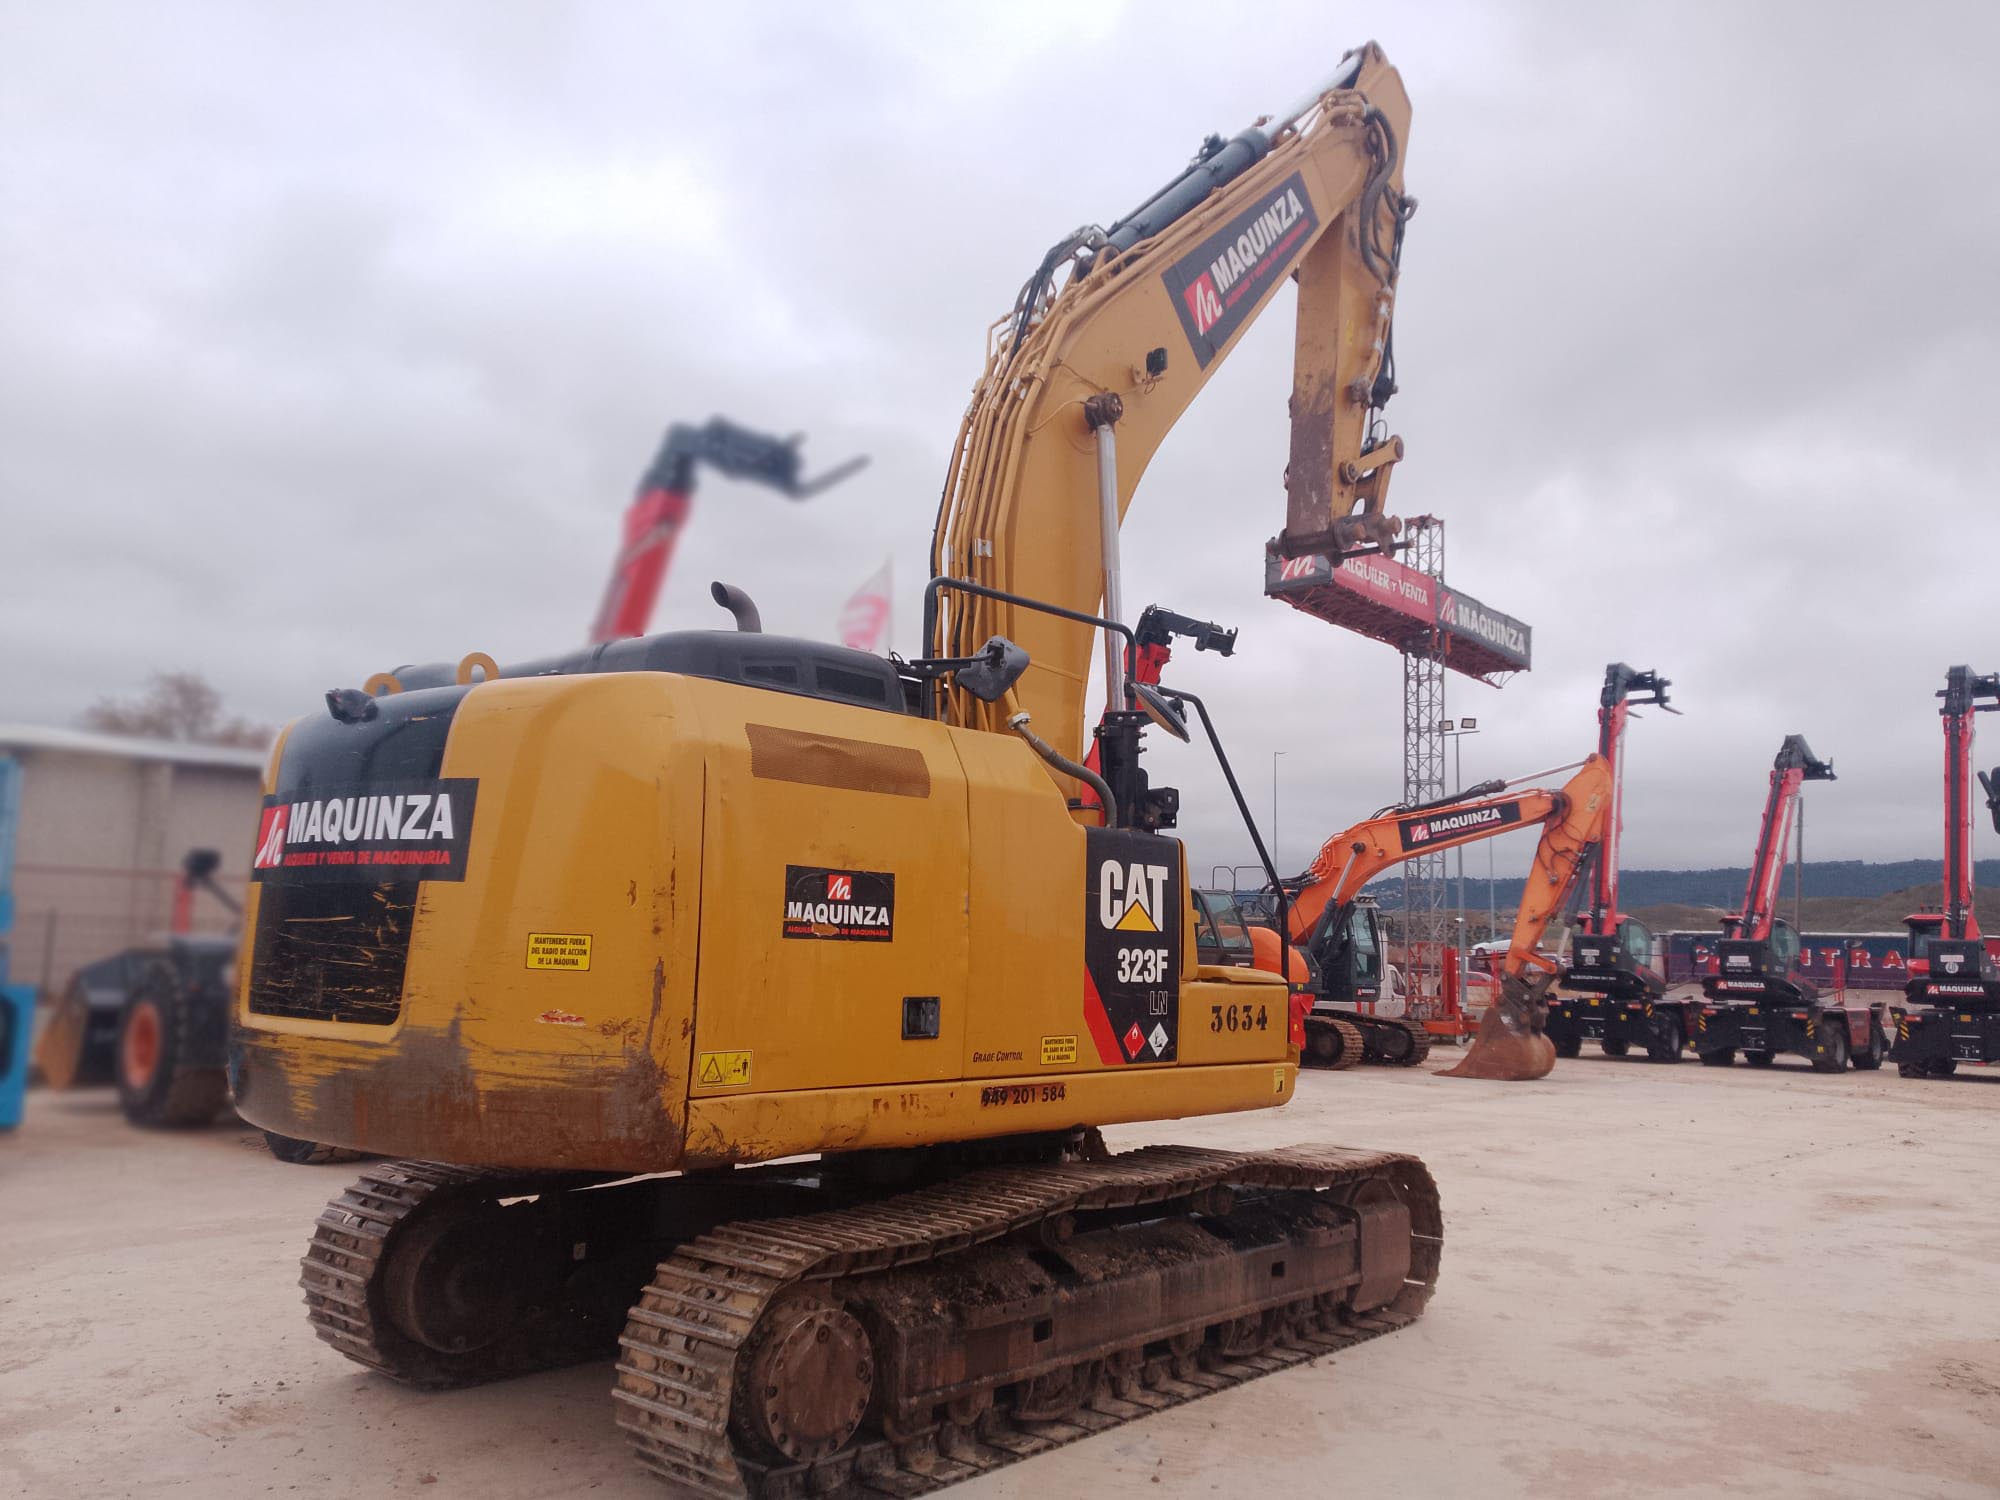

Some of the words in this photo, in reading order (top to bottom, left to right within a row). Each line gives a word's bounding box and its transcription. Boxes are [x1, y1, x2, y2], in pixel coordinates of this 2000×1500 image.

[1210, 188, 1304, 294] MAQUINZA
[1342, 557, 1390, 591] ALQUILER
[1398, 579, 1428, 606] VENTA
[1458, 603, 1526, 655] MAQUINZA
[286, 793, 455, 845] MAQUINZA
[1430, 808, 1501, 833] MAQUINZA
[357, 851, 371, 864] DE
[1100, 859, 1169, 932] CAT
[787, 901, 890, 926] MAQUINZA
[531, 947, 541, 955] DEL
[542, 947, 559, 955] RADIO
[534, 937, 568, 946] MANTENERSE
[569, 937, 586, 945] FUERA
[537, 957, 545, 965] DE
[546, 957, 552, 965] LA
[553, 958, 579, 966] MAQUINA
[1117, 948, 1169, 983] 323F
[1940, 985, 1984, 993] MAQUINZA
[1149, 991, 1168, 1015] LN
[1210, 1005, 1268, 1033] 3634
[1013, 1087, 1036, 1104] 201
[1041, 1085, 1065, 1102] 584
